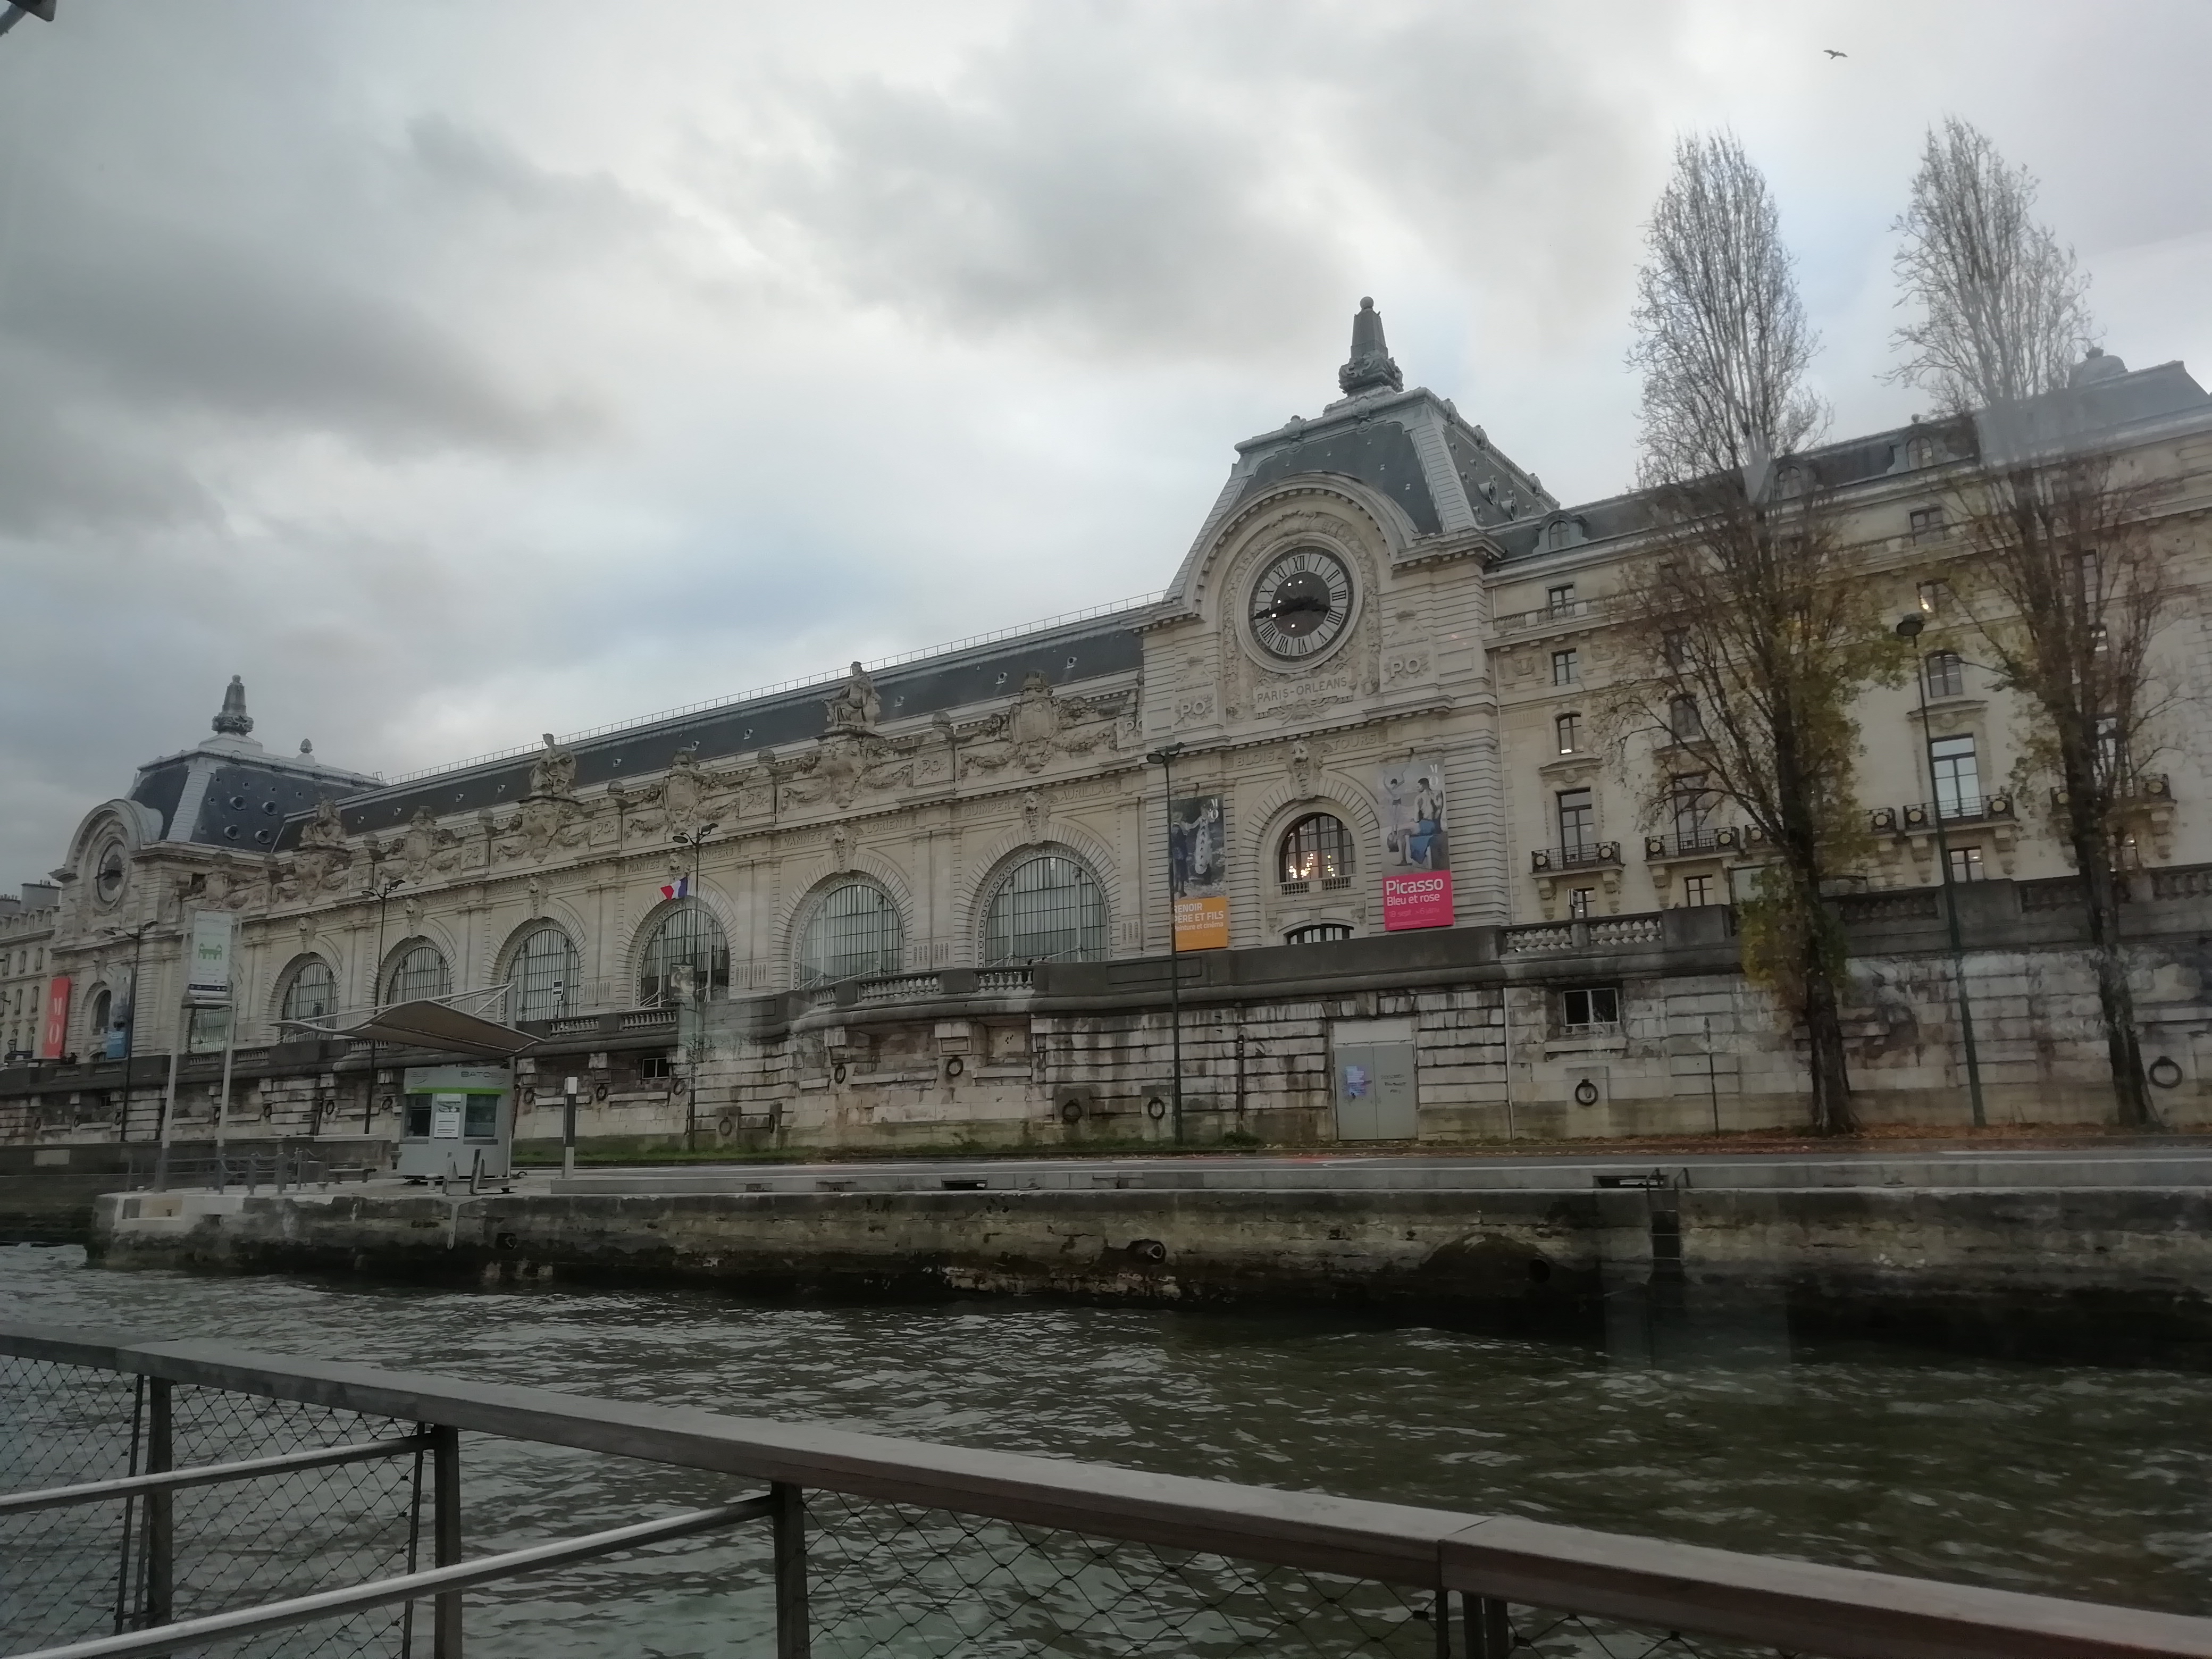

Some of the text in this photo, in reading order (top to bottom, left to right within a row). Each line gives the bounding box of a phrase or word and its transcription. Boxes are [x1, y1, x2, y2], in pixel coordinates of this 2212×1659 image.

[1390, 658, 1421, 677] PO
[1257, 677, 1347, 703] PARIS-ORLEANS
[1180, 700, 1206, 718] PO
[1331, 733, 1376, 750] TOURS
[1236, 751, 1275, 766] BLOIS
[1059, 783, 1112, 801] AURILLAC
[962, 800, 1010, 817] QUIMPER
[867, 817, 909, 833] LORIENT
[784, 832, 822, 847] VANNES
[627, 860, 660, 873] NANTES
[1386, 879, 1444, 895] Picasso
[1174, 902, 1203, 913] RENOIR
[1387, 893, 1440, 906] Bleu et rose
[1195, 912, 1205, 921] ET
[1206, 911, 1224, 920] FILS
